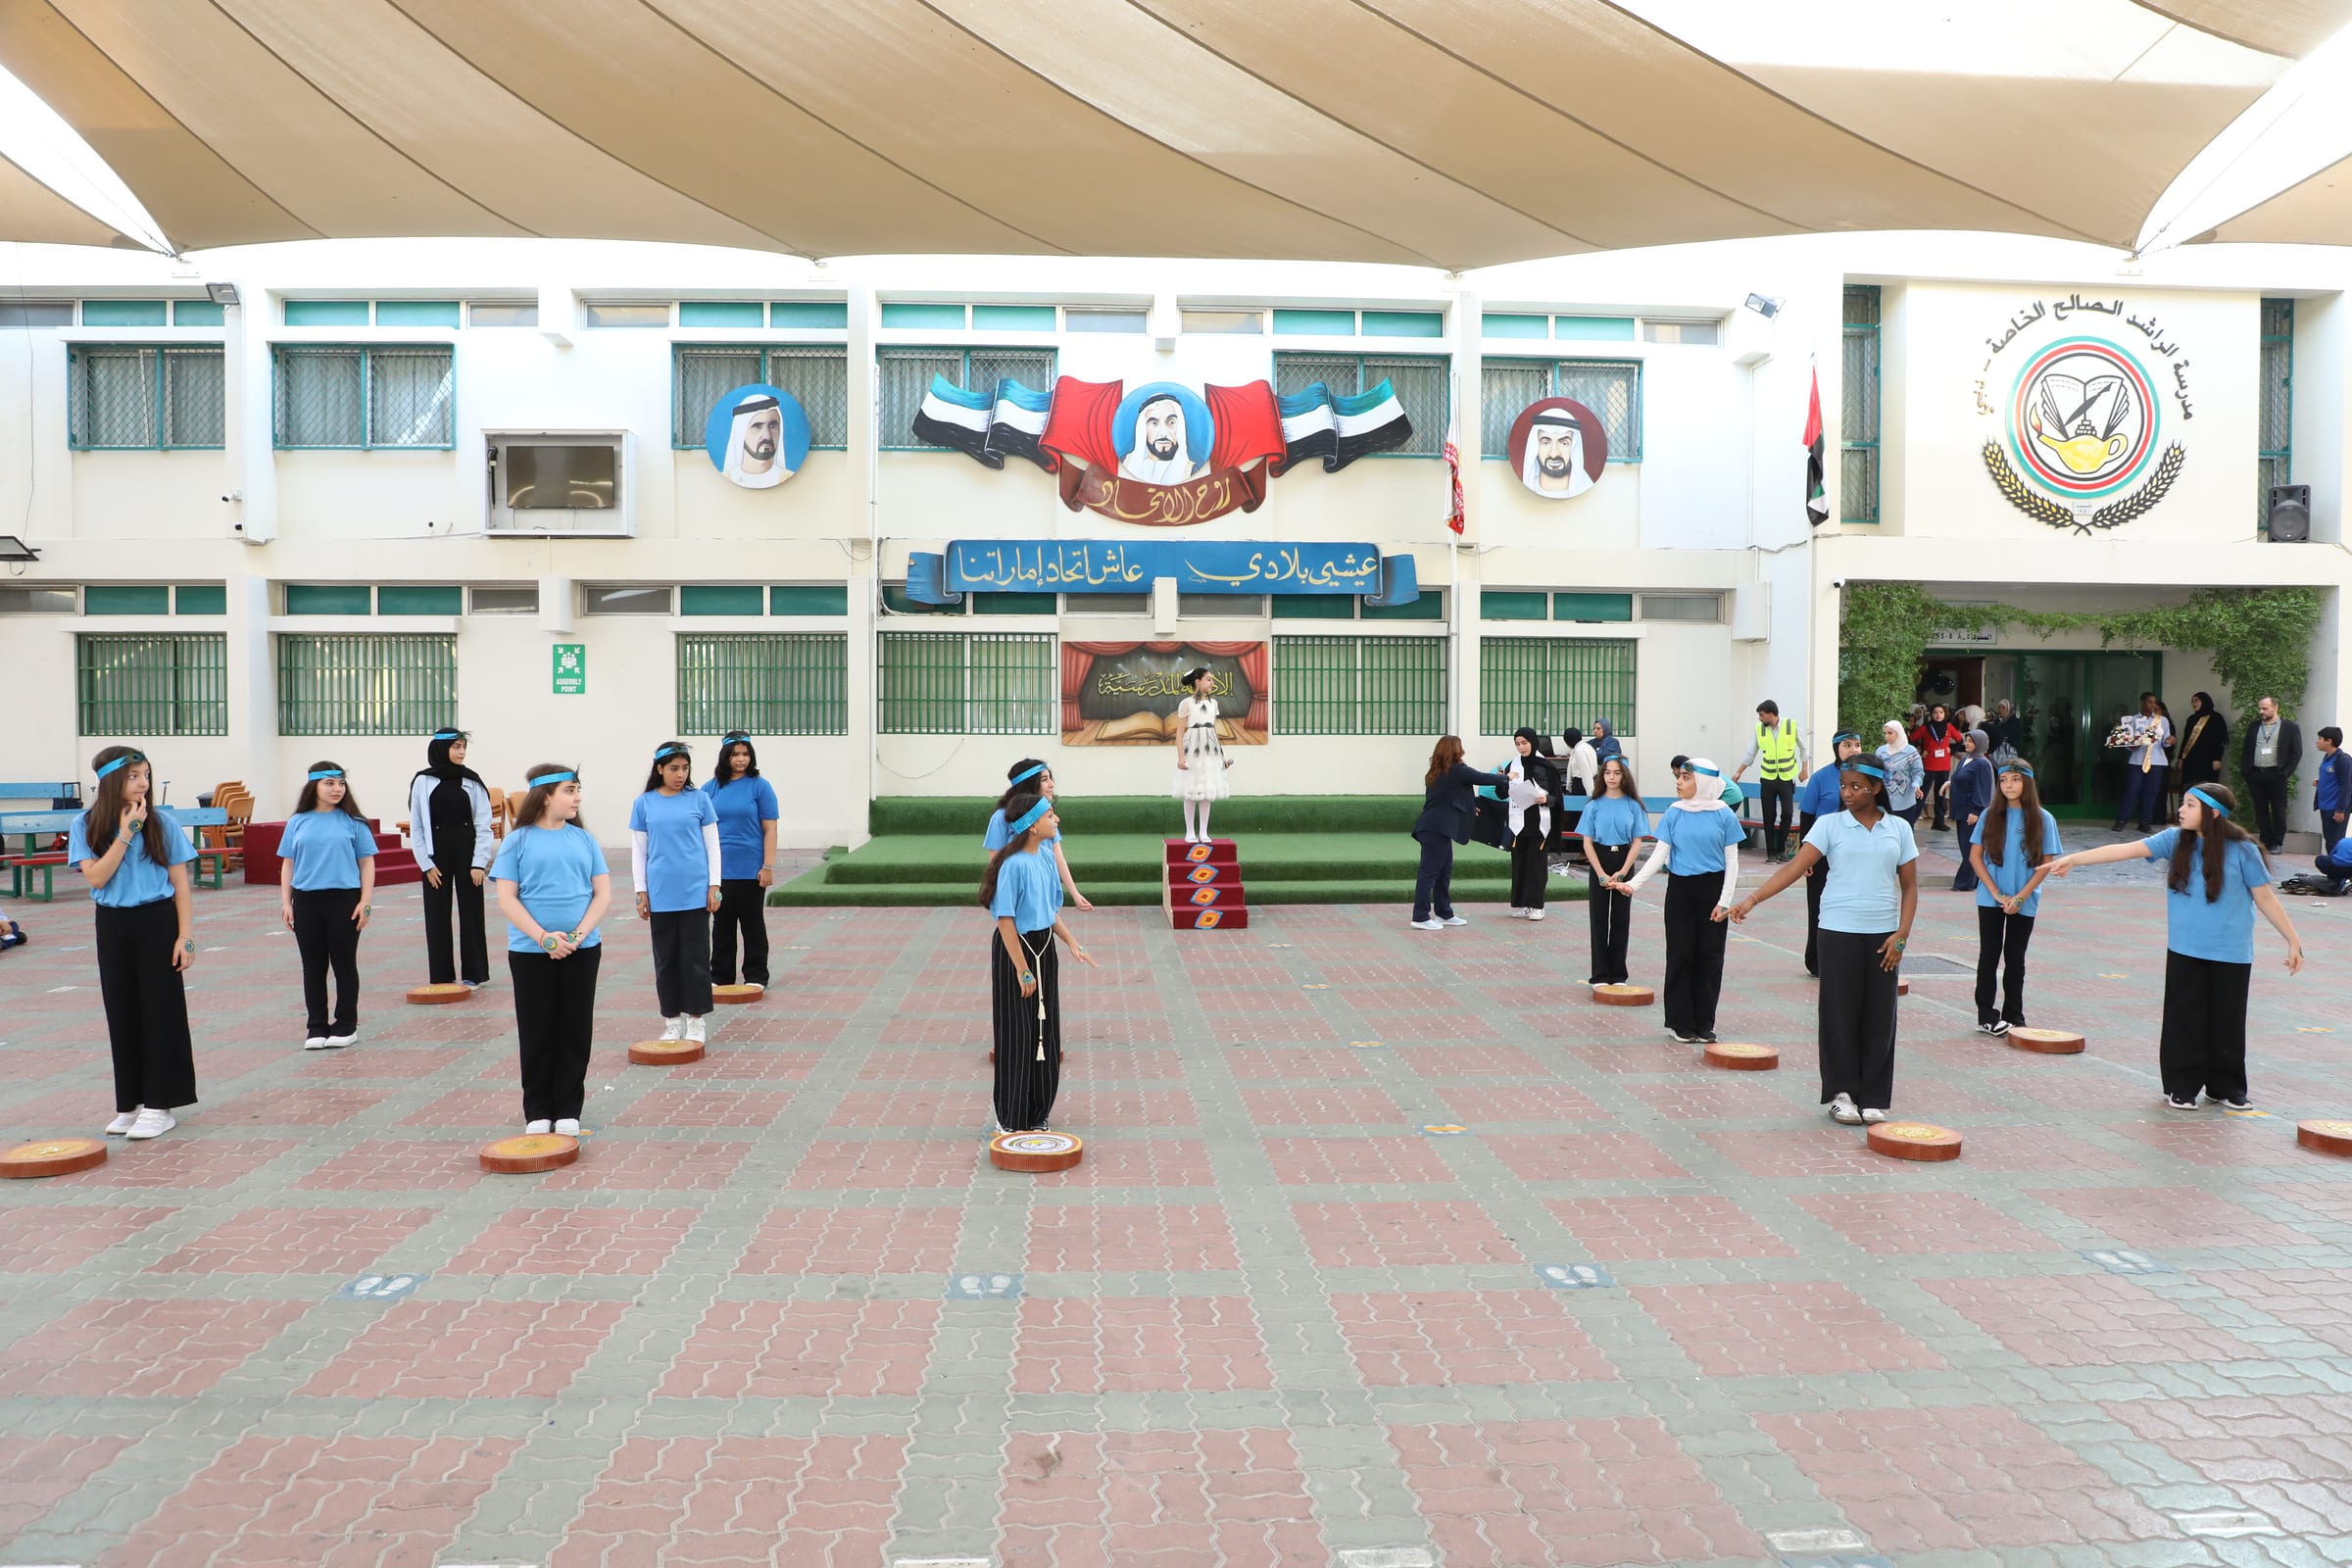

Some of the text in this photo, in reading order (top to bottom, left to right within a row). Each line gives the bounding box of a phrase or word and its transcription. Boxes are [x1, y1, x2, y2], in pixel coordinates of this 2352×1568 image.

[1985, 300, 2046, 354] الخاصة
[2052, 293, 2124, 320] الصالح
[2126, 314, 2180, 358] الراشد
[2173, 360, 2193, 420] مدرسة
[1087, 476, 1231, 525] روح الاتحاد
[957, 544, 1378, 588] عيشي بلادي عاش اتحاد إماراتنا
